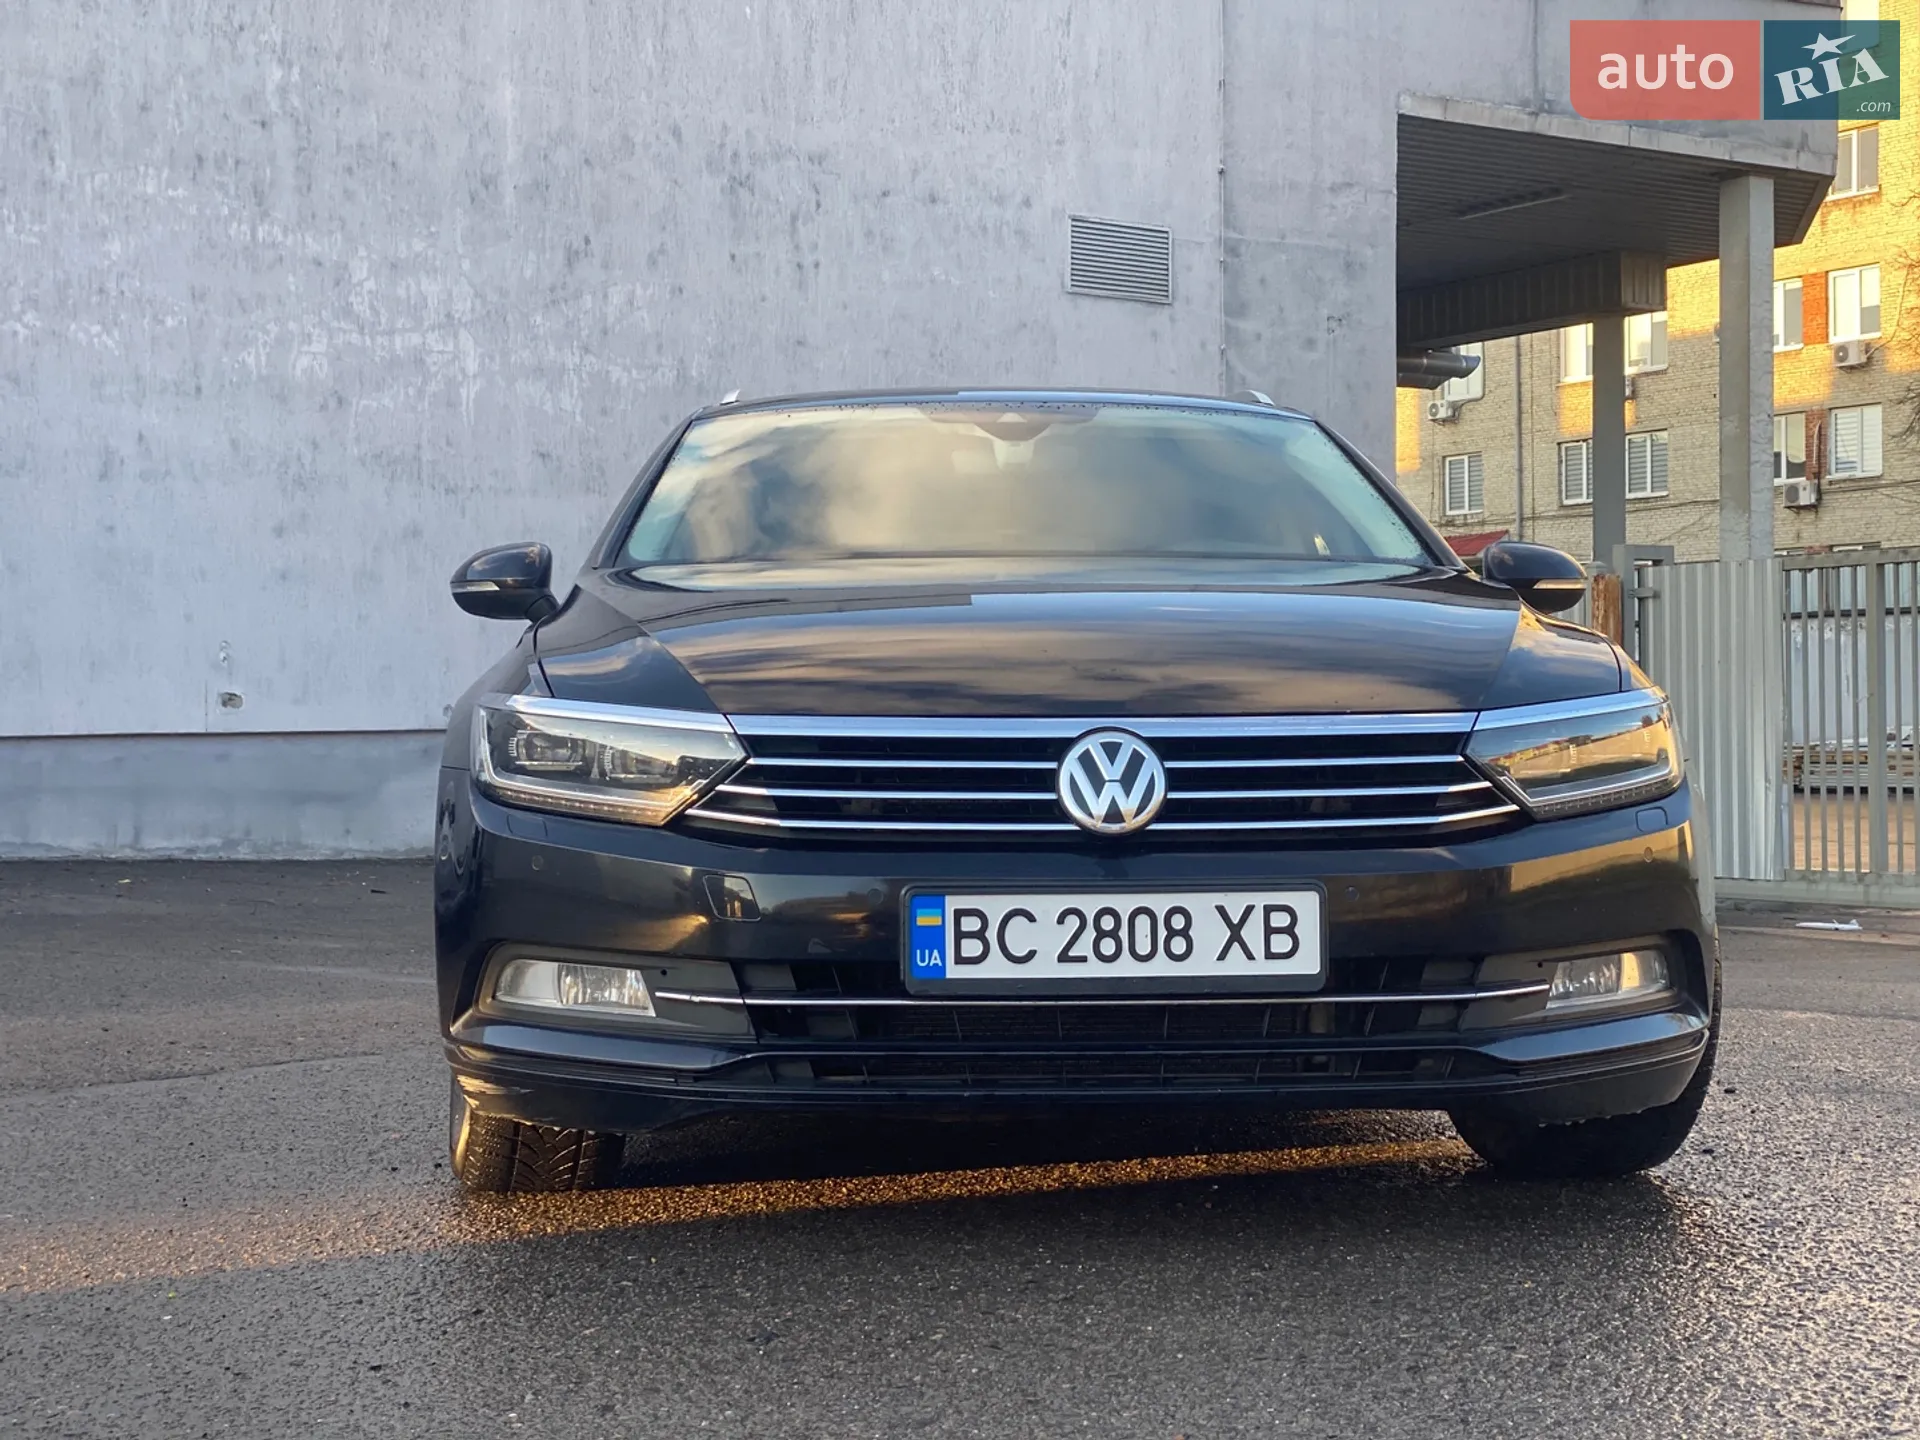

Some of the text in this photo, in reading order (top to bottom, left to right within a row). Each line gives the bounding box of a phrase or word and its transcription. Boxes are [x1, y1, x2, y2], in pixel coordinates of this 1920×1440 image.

[1060, 731, 1166, 834] VW
[916, 949, 943, 967] UA
[953, 903, 1301, 966] BC 2808 XB
